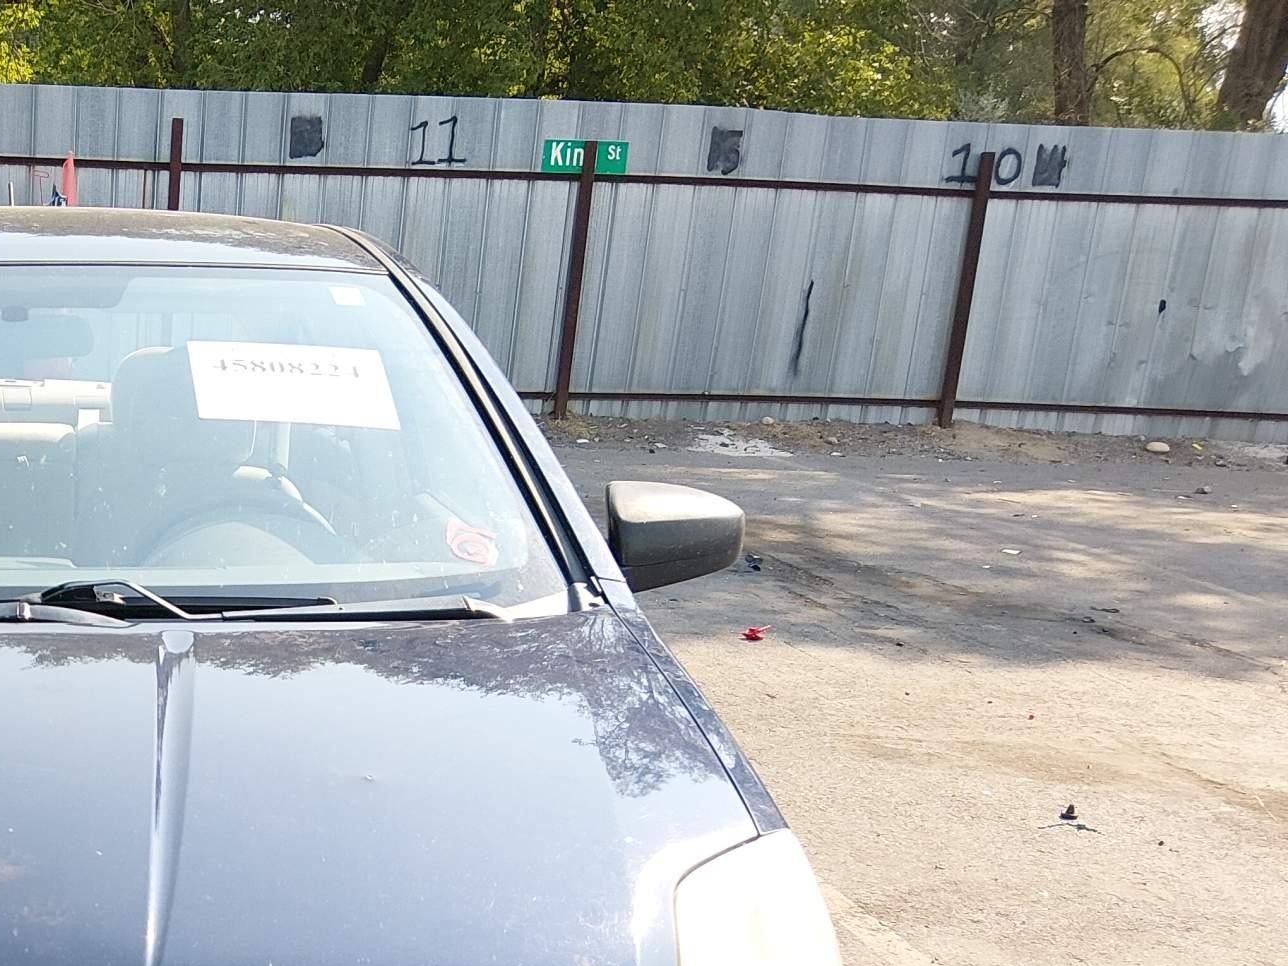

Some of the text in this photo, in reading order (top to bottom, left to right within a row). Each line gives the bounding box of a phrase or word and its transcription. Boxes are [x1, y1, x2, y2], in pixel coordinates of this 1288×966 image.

[410, 115, 467, 165] 11
[550, 141, 622, 167] Kin St
[945, 143, 1022, 186] 10
